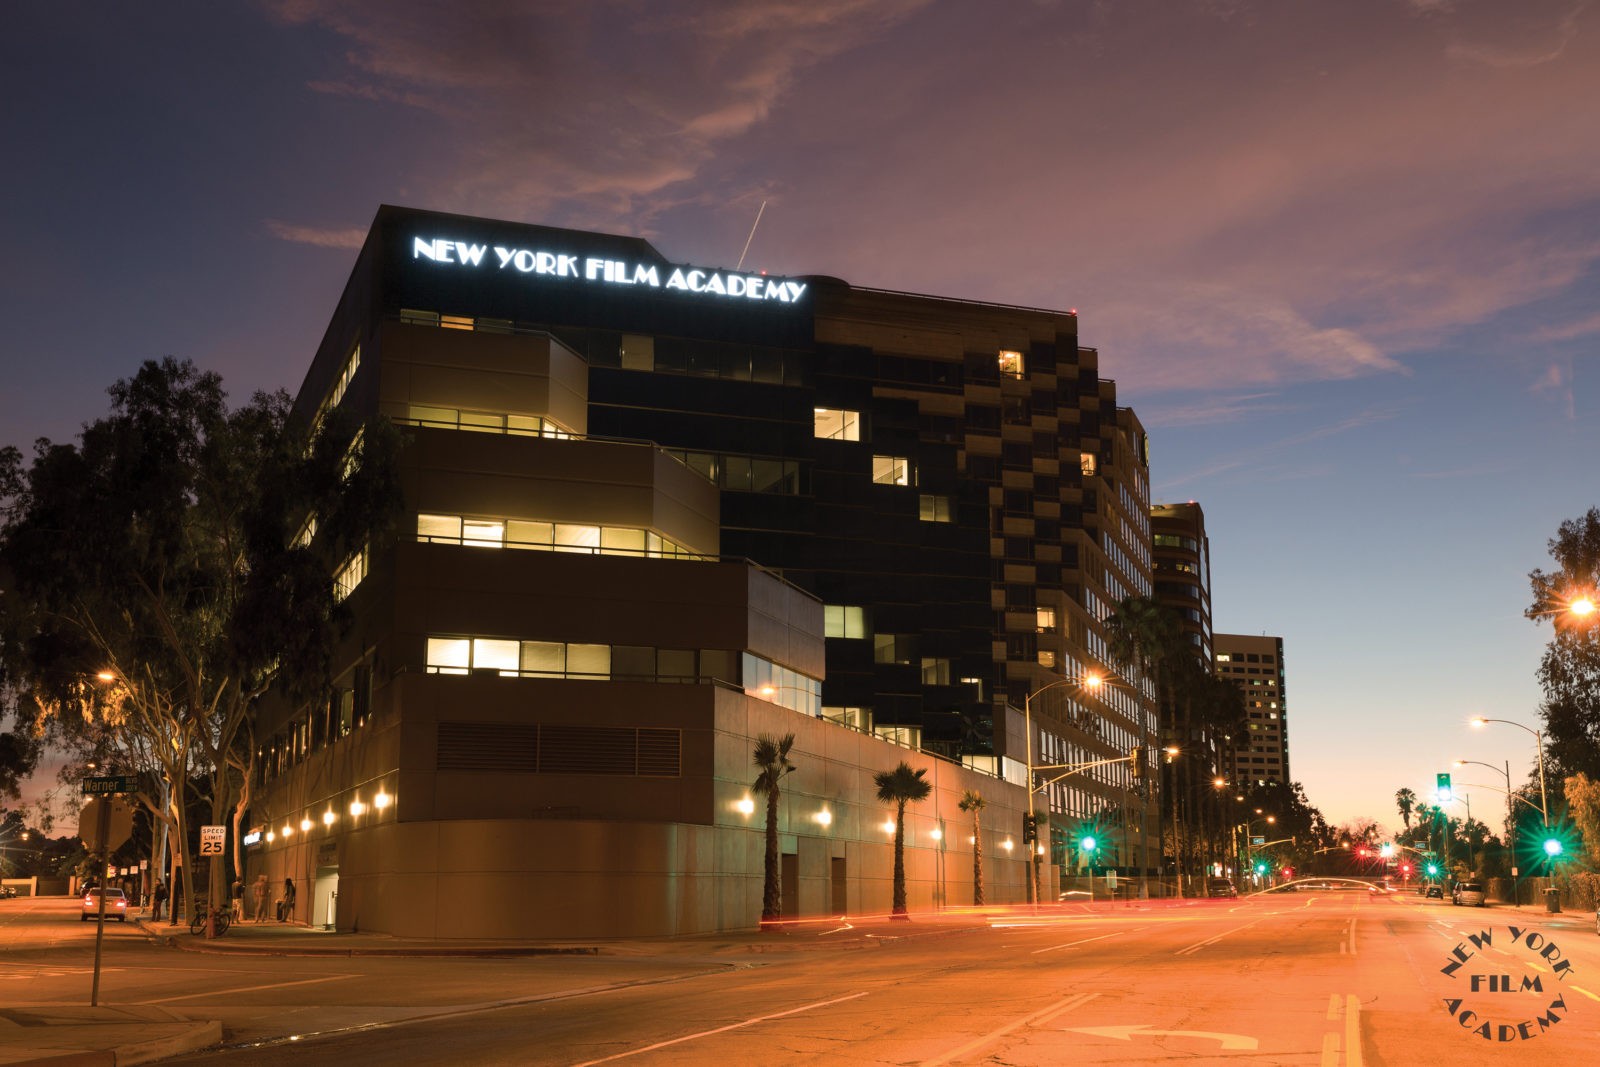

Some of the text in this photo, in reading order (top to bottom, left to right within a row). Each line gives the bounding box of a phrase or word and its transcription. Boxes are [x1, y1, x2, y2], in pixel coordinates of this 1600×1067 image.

[413, 236, 807, 303] NEW YORK FILM ACADEMY
[84, 779, 119, 792] Warner
[203, 842, 222, 853] 25
